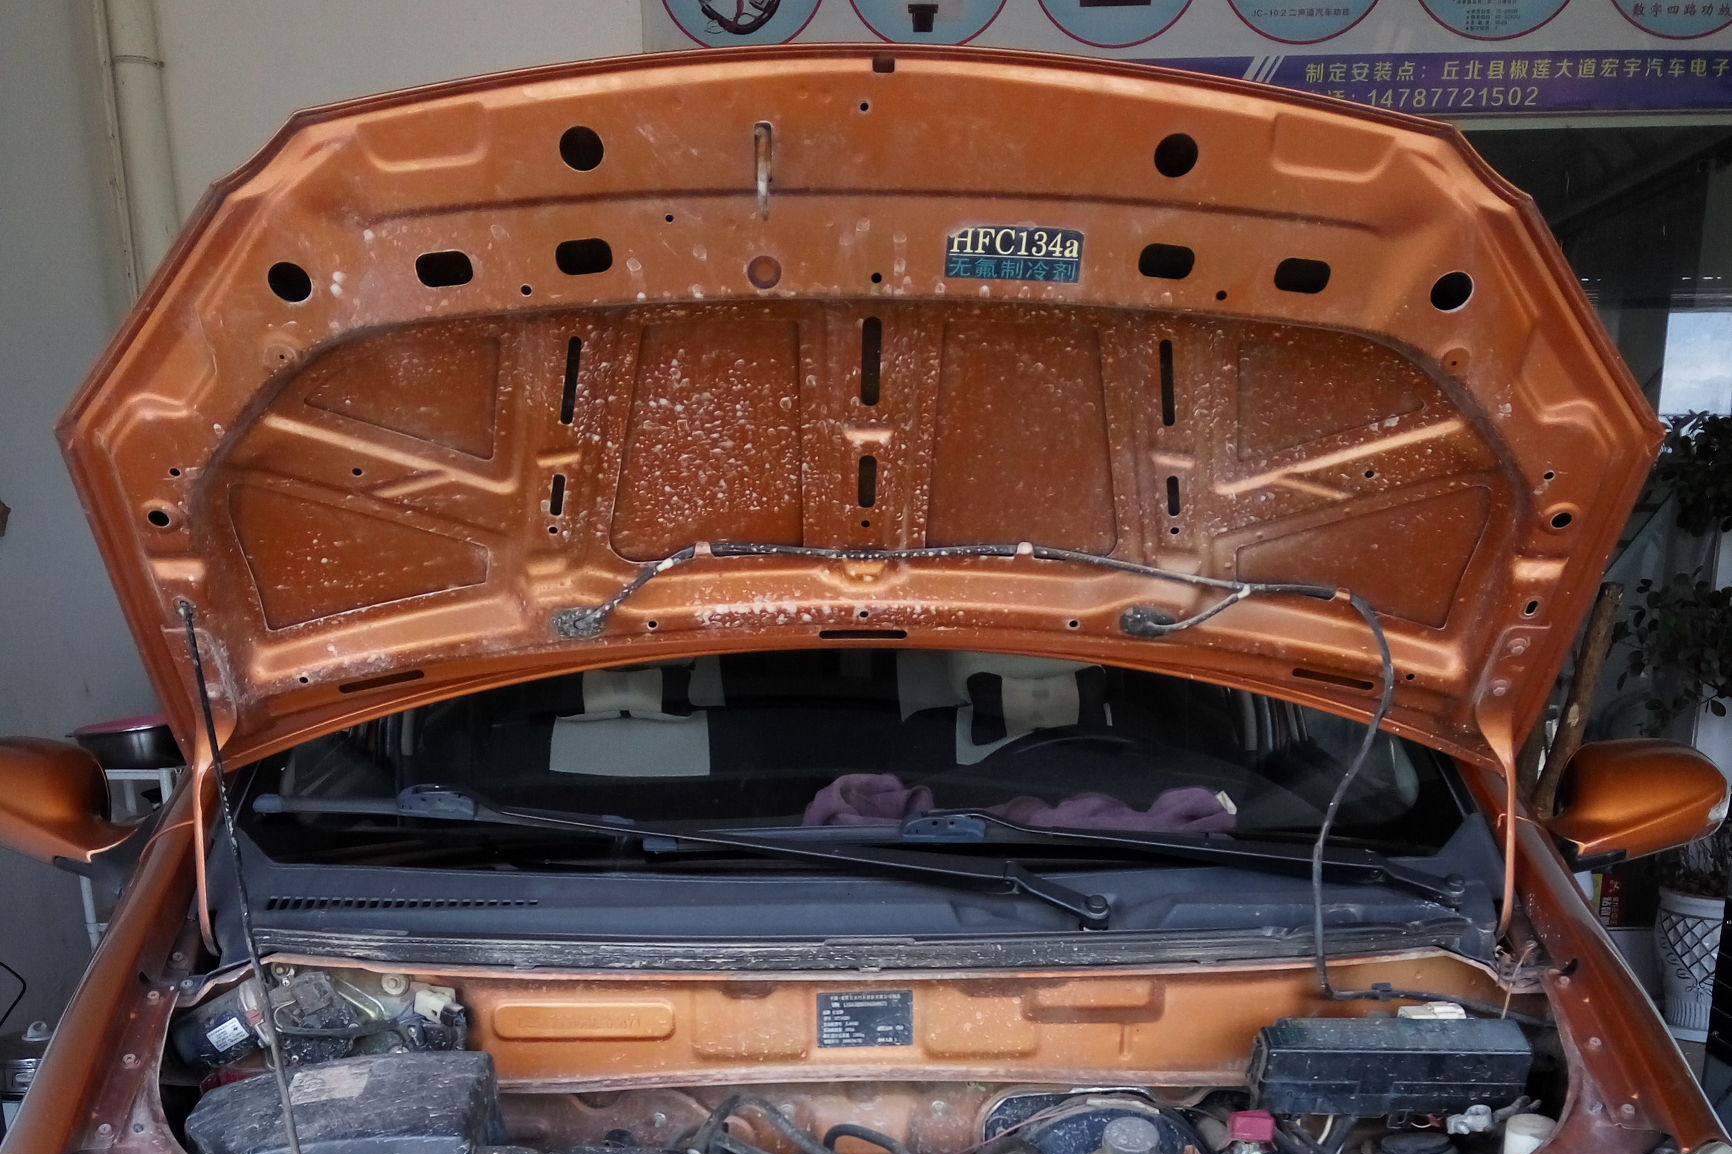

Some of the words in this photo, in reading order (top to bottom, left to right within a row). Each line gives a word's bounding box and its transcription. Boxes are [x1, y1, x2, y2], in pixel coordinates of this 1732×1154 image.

[951, 228, 1078, 257] HFC134a
[950, 258, 1076, 281] 无氟制冷剂
